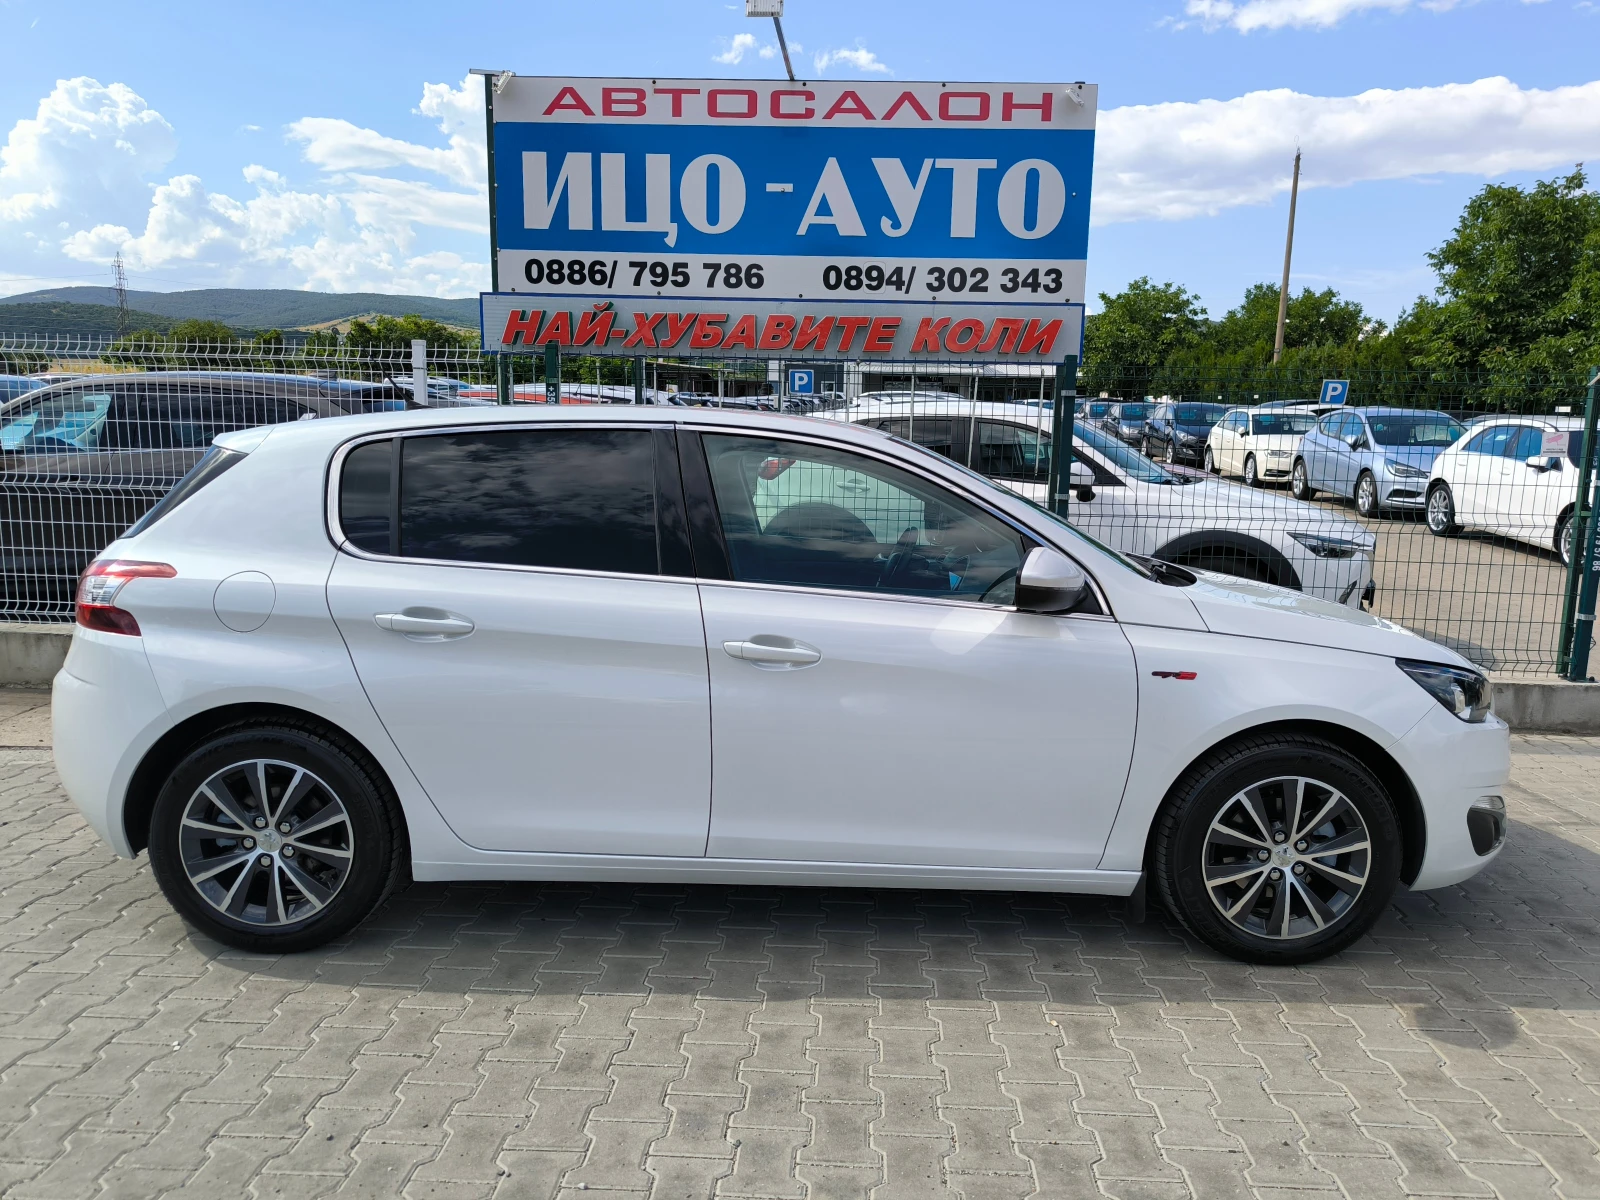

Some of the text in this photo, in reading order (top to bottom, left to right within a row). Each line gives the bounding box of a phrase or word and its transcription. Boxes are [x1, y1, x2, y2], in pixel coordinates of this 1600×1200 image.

[541, 86, 1053, 122] АВТОСАЛОН
[524, 258, 765, 290] 0886/ 795 786
[822, 264, 1064, 295] 0894/ 302 343
[501, 301, 1065, 355] НАЙ-ХУБАВИТЕ КОЛИ
[794, 372, 809, 391] P
[1325, 382, 1343, 402] P
